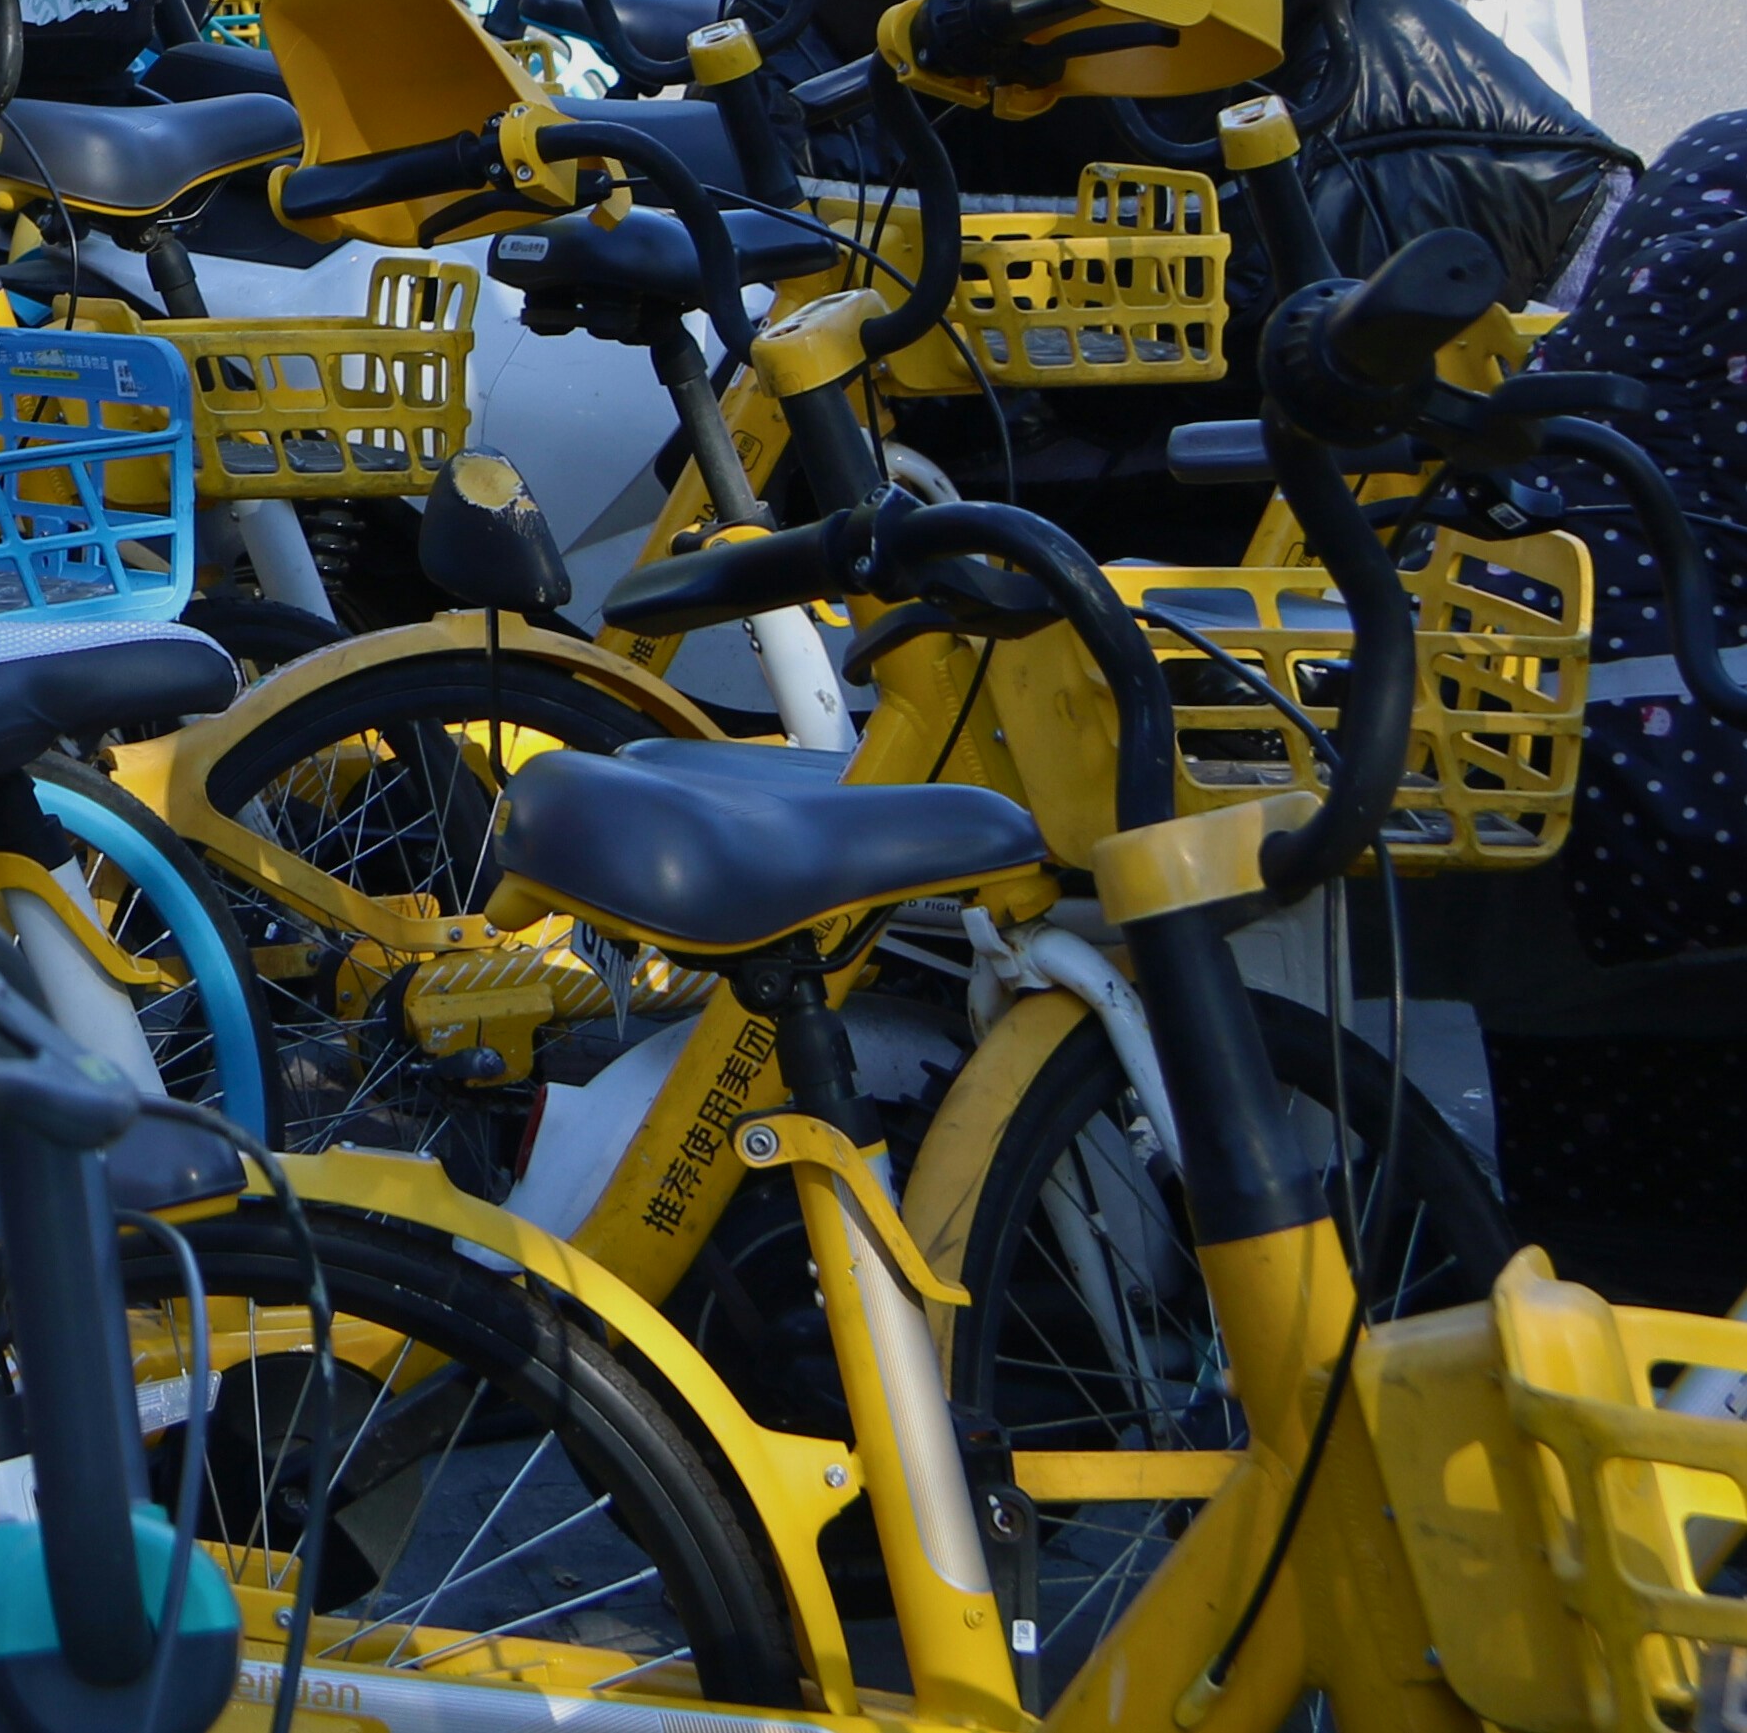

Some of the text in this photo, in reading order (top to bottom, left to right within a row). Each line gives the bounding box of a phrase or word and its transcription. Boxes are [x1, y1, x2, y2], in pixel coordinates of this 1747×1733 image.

[642, 1019, 777, 1237] 推荐使用美团
